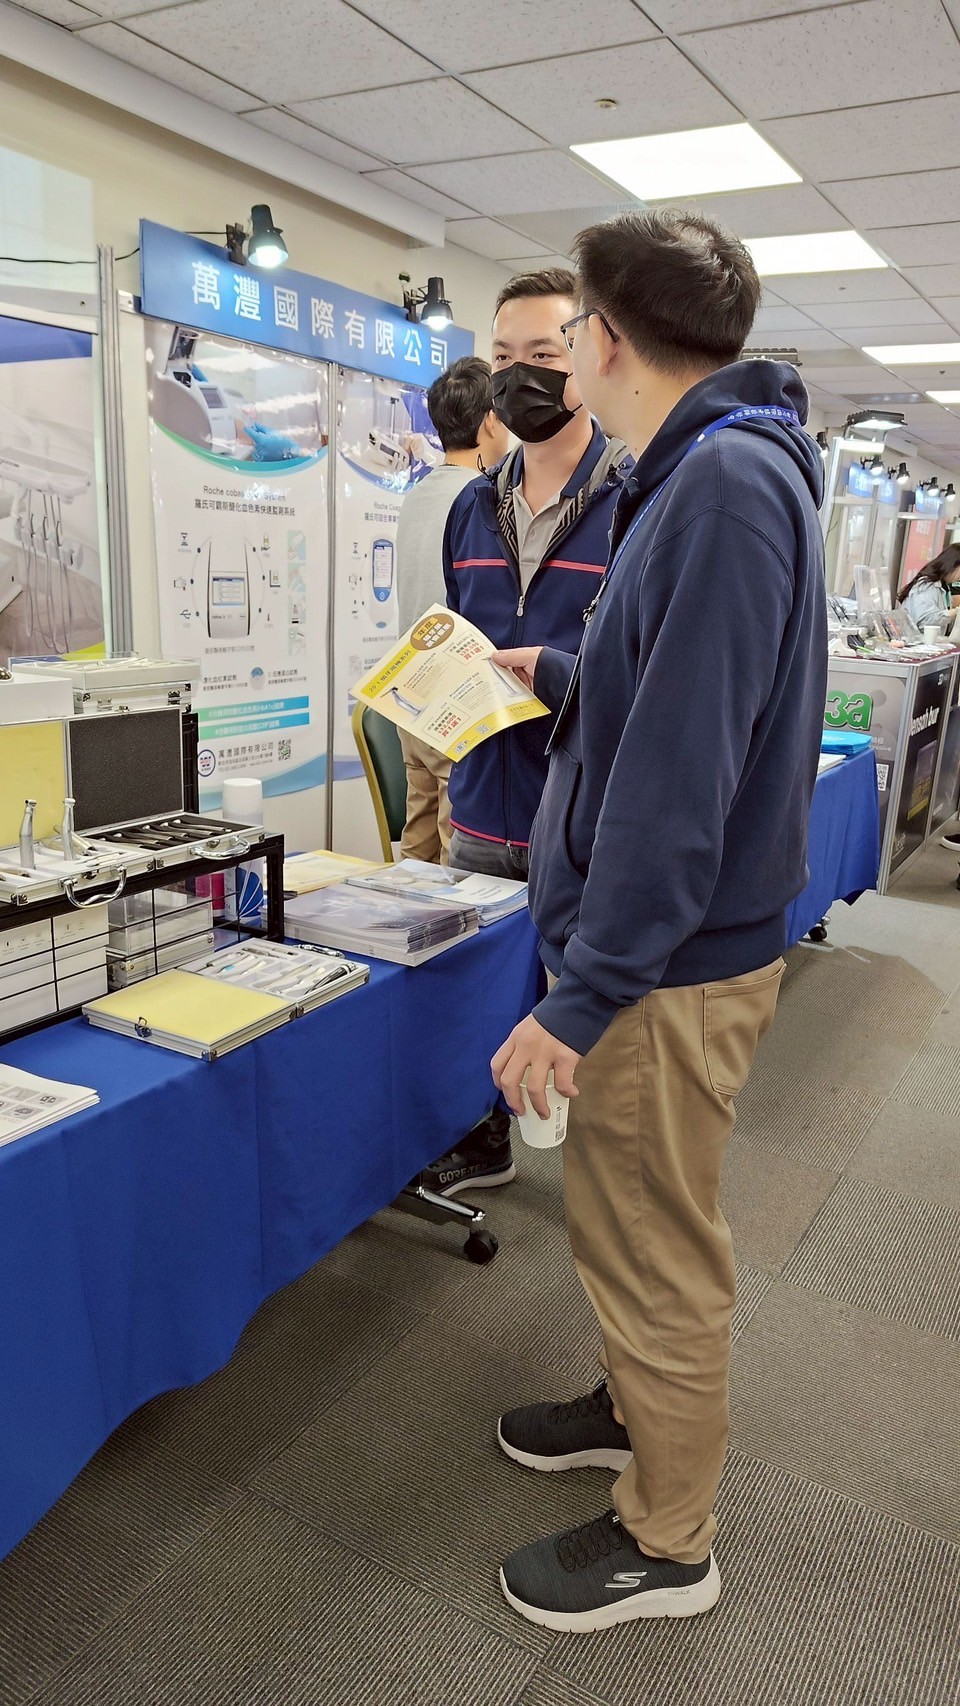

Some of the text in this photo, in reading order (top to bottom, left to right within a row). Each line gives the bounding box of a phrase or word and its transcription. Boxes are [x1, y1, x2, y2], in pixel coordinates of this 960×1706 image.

[191, 261, 449, 372] 萬灃國際有限公司
[203, 485, 224, 496] Roche
